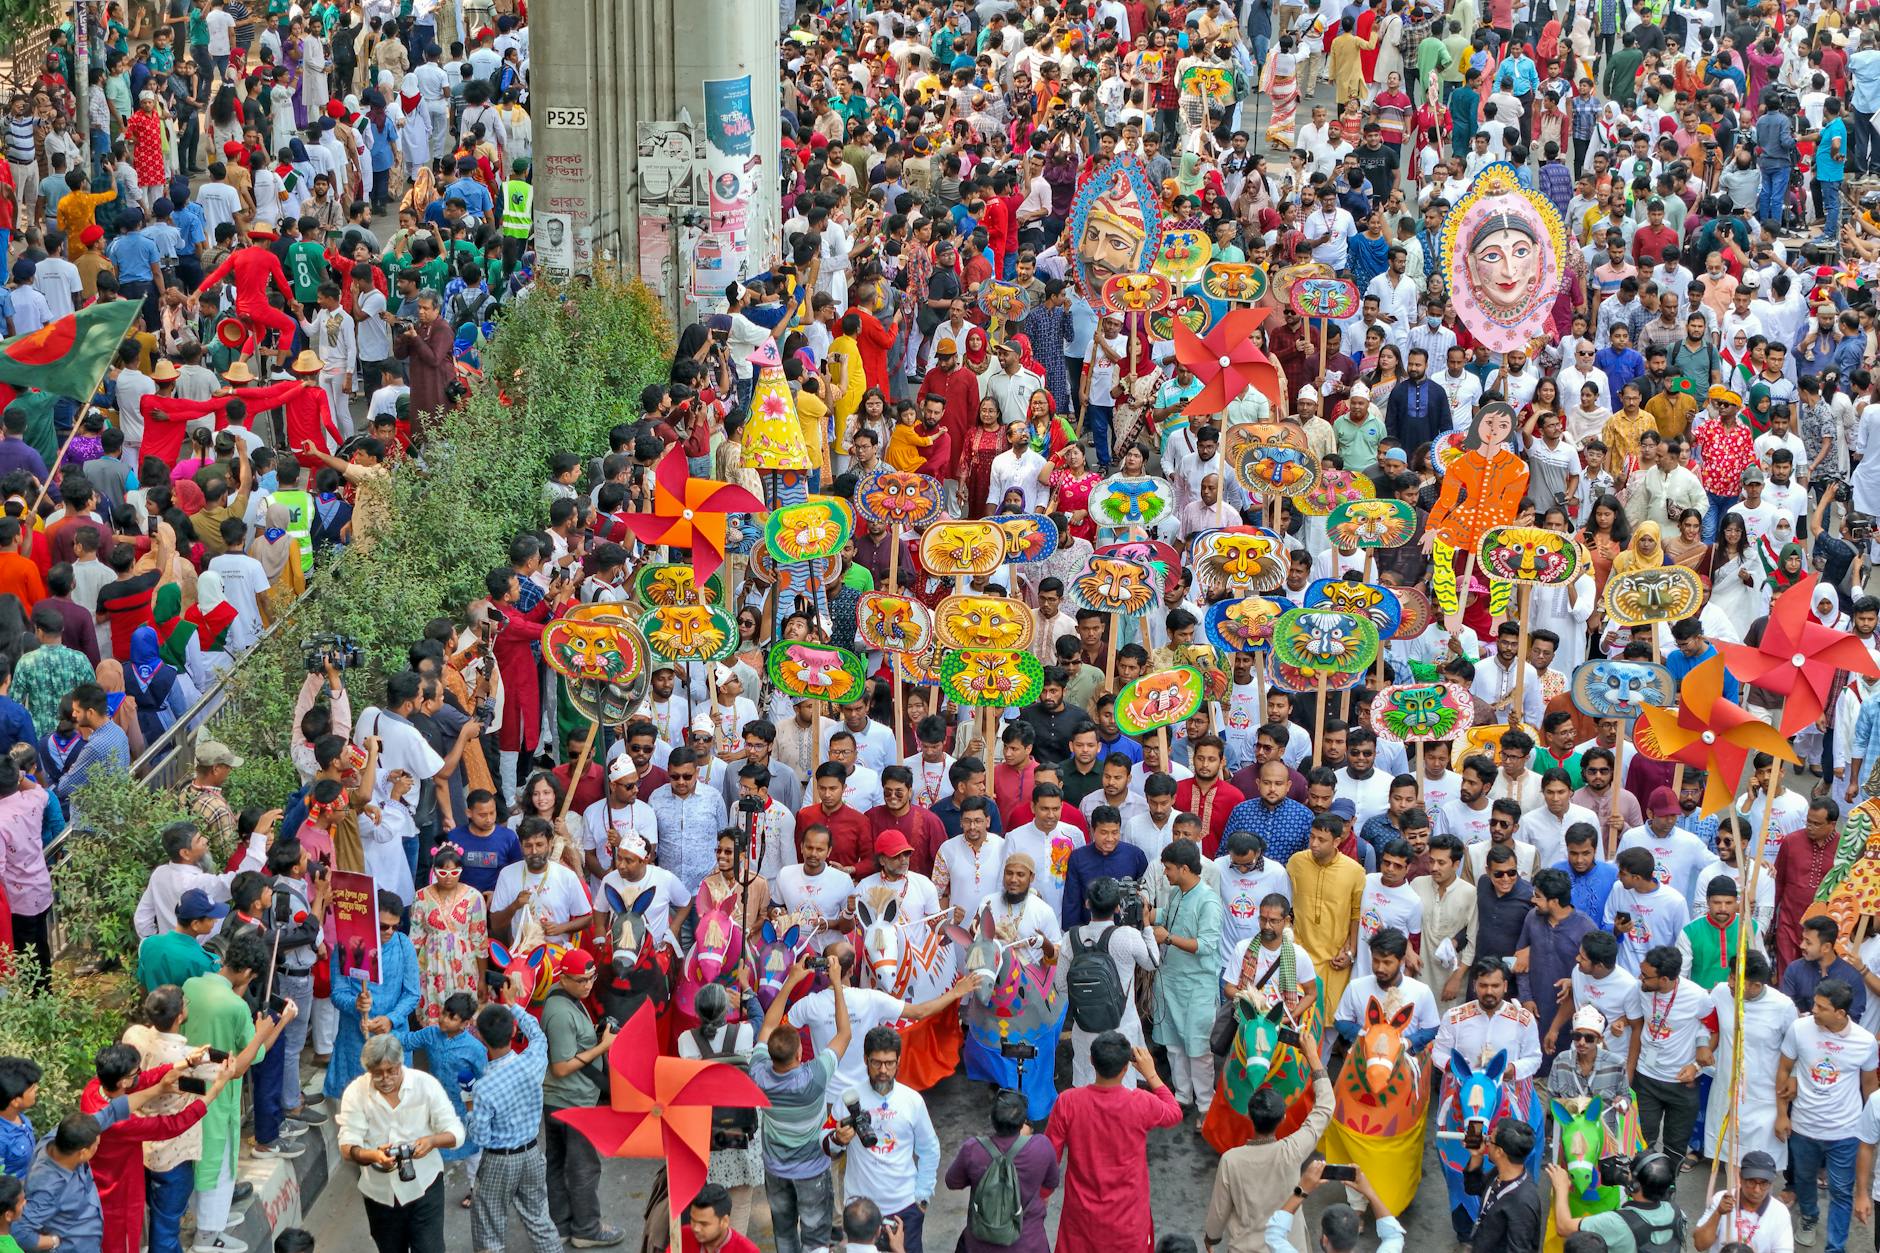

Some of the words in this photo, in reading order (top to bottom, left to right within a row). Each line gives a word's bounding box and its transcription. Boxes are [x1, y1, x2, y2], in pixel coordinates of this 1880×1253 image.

[547, 111, 585, 126] P525
[545, 154, 582, 164] বয়কট
[545, 165, 584, 176] ইন্ডিয়া
[298, 263, 310, 288] 8
